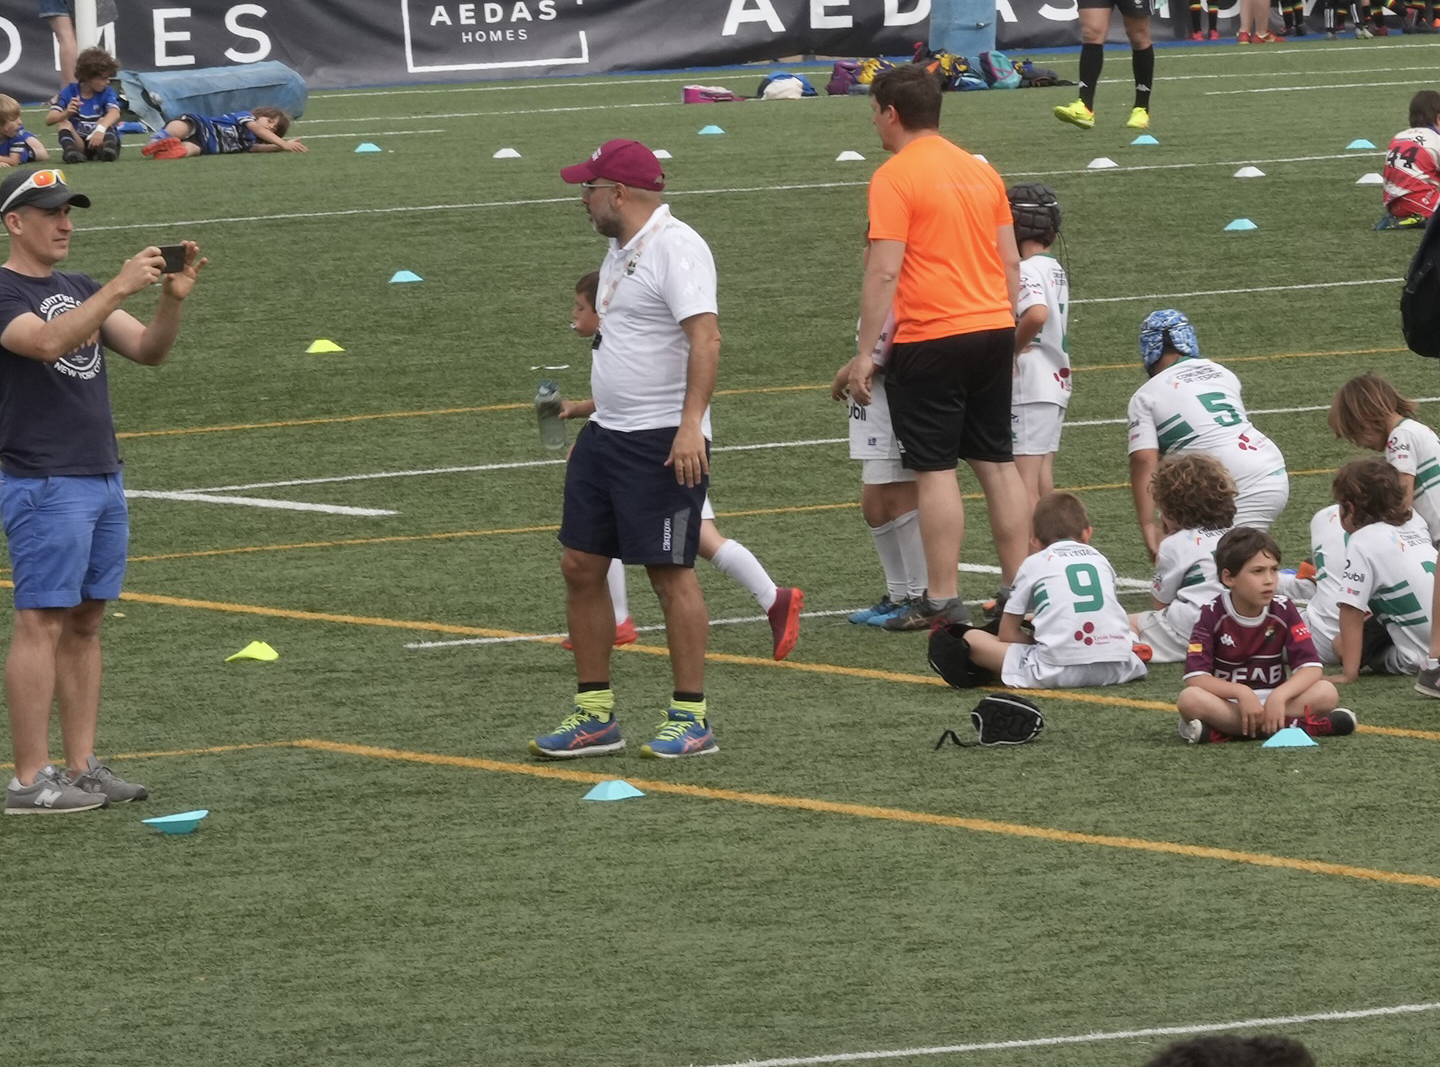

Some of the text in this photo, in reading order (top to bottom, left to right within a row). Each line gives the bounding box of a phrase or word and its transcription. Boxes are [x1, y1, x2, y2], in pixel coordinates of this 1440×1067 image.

[430, 0, 557, 26] AEDAS
[462, 29, 528, 43] HOMES
[54, 361, 77, 377] NEW
[78, 368, 97, 380] YORK
[848, 405, 866, 421] ubli
[1196, 391, 1242, 427] 5
[1065, 563, 1104, 613] 9
